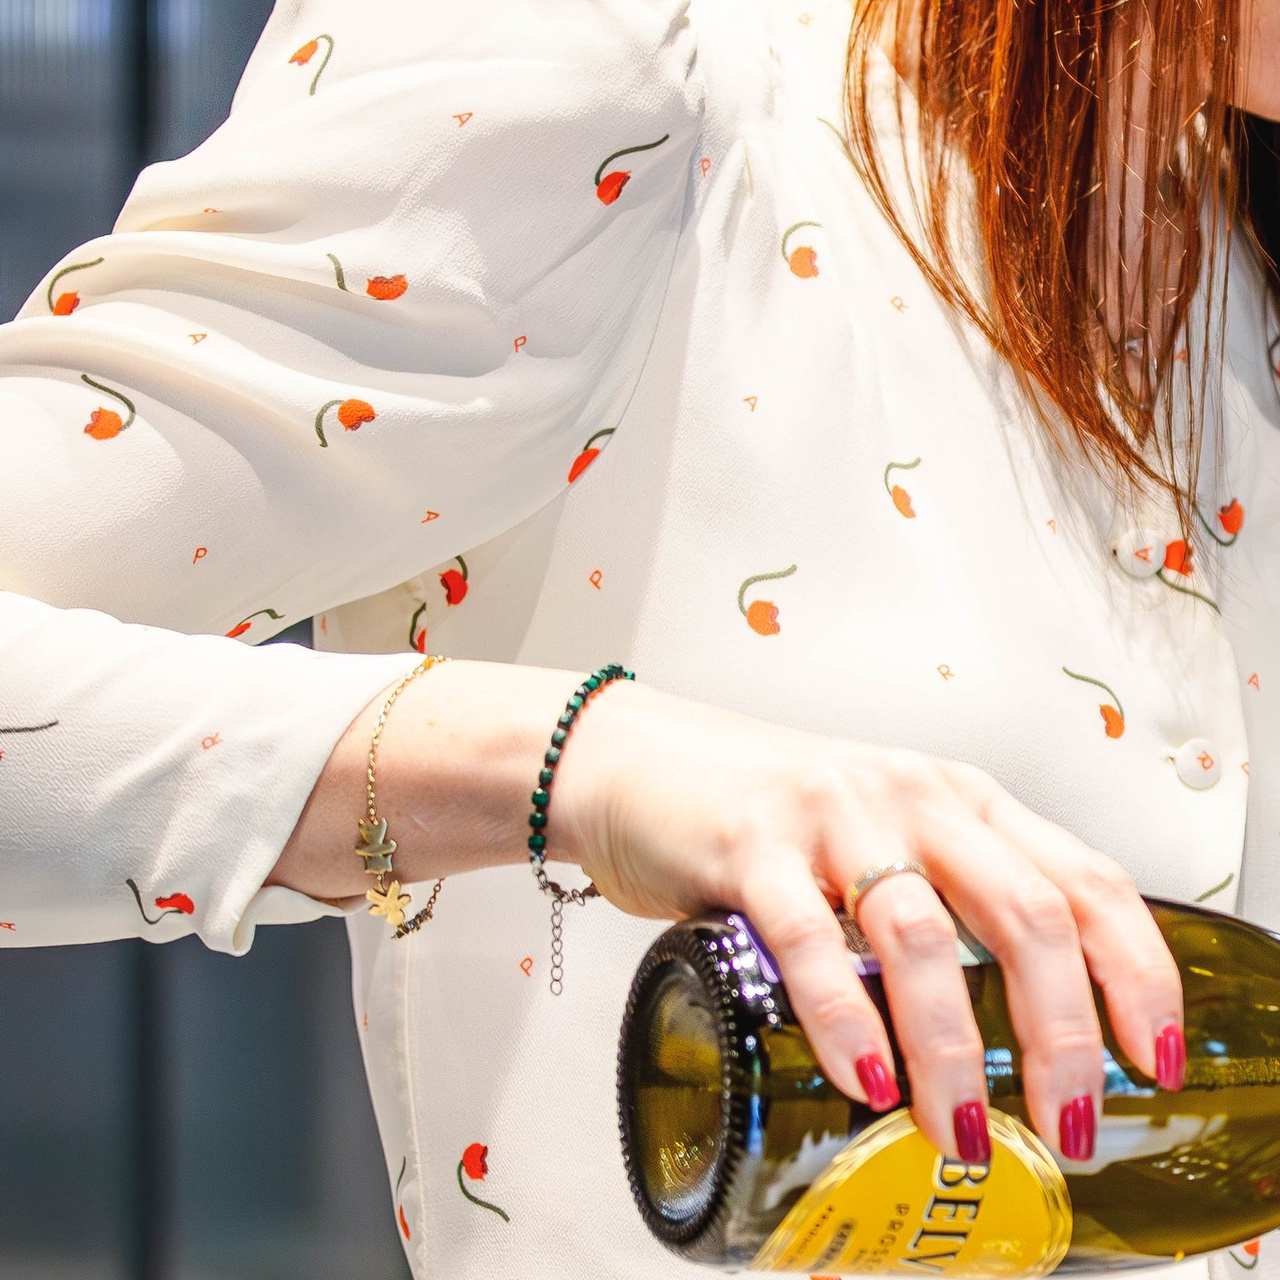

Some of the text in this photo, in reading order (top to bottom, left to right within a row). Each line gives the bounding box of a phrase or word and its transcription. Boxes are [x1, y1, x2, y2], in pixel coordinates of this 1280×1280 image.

[451, 111, 475, 129] A
[700, 157, 712, 179] P
[890, 296, 909, 313] R
[189, 332, 208, 345] A
[513, 335, 529, 354] P
[742, 396, 759, 413] A
[420, 509, 440, 525] A
[192, 545, 209, 565] P
[1133, 546, 1153, 565] A
[588, 569, 604, 590] P
[936, 664, 955, 682] R
[1246, 672, 1260, 692] A
[200, 731, 221, 752] R
[1196, 750, 1215, 772] R
[519, 956, 534, 978] P
